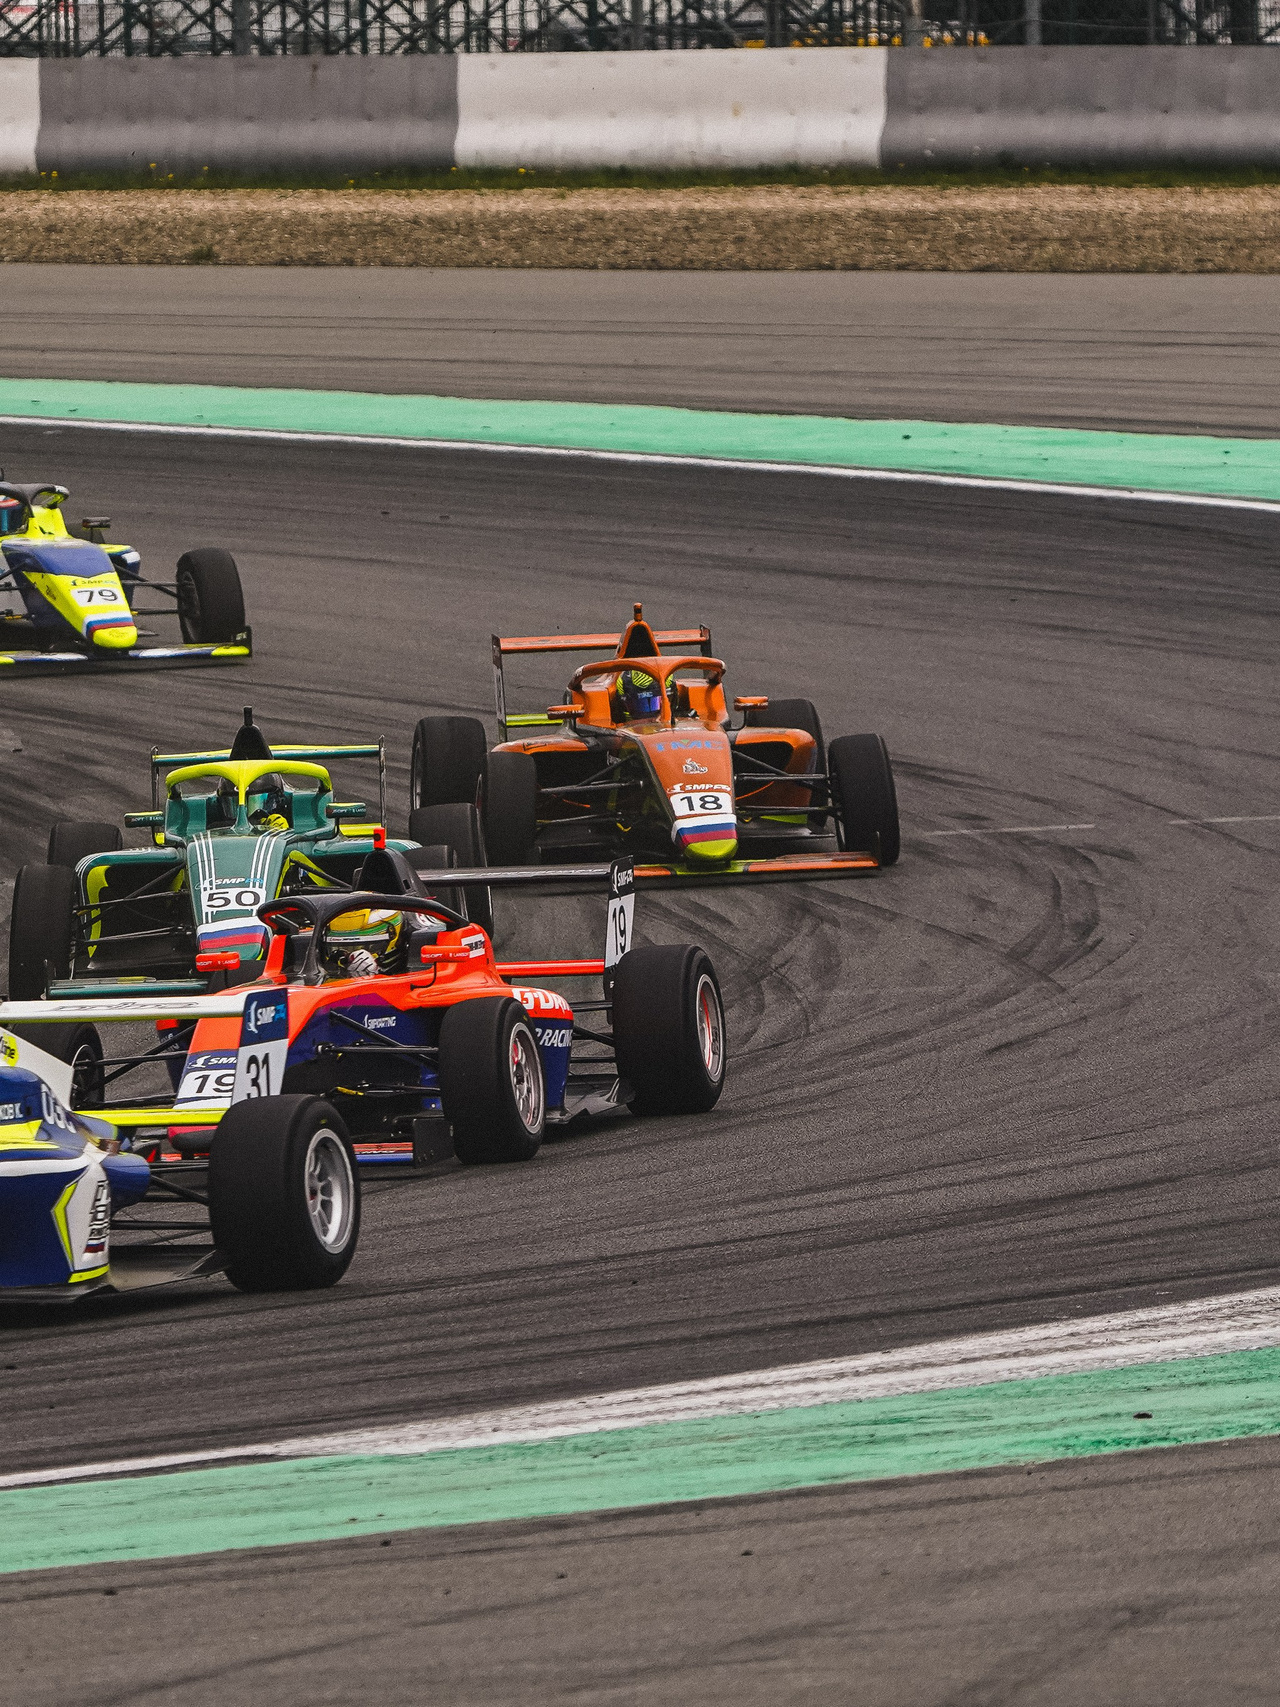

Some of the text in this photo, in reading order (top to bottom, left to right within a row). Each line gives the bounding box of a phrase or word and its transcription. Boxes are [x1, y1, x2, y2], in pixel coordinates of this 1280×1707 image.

[77, 589, 118, 602] 79
[680, 795, 723, 811] 18
[206, 890, 261, 908] 50
[613, 905, 626, 955] 19
[194, 1073, 235, 1093] 19
[246, 1052, 270, 1099] 31
